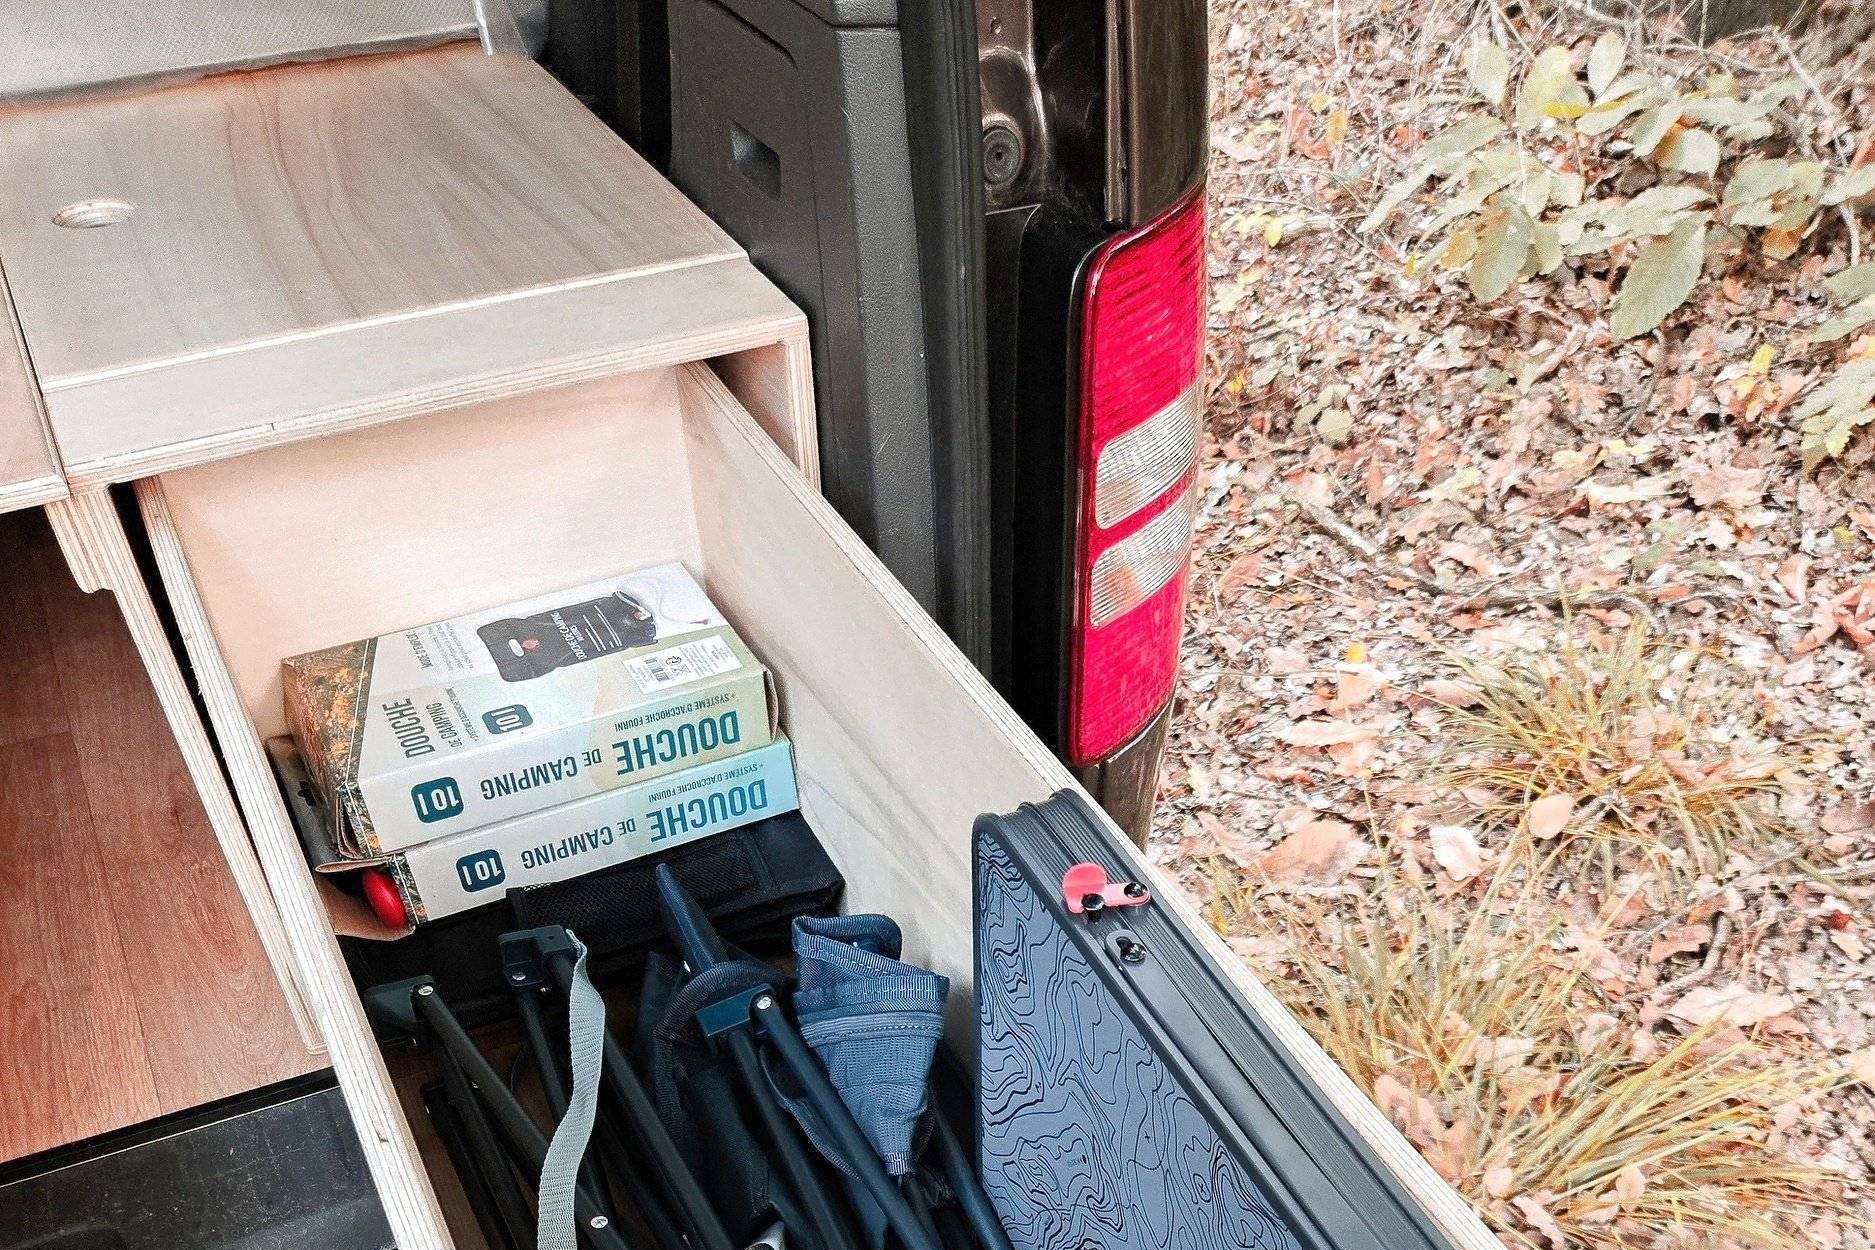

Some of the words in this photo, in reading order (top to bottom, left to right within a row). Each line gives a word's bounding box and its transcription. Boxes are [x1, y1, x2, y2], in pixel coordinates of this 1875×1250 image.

[426, 702, 458, 739] CAMPING
[495, 714, 523, 731] 10
[615, 718, 644, 732] FOURNI
[645, 702, 694, 725] D'ACCROCHE
[382, 698, 435, 758] DOUCHE
[448, 737, 463, 748] DE
[612, 710, 741, 775] DOUCHE
[582, 749, 602, 767] DE
[479, 756, 578, 801] CAMPING
[677, 774, 724, 795] D'ACCROCHE
[432, 786, 460, 811] 10
[648, 789, 677, 803] FOURNI
[646, 778, 769, 843] DOUCHE
[617, 817, 637, 836] DE
[521, 826, 614, 869] CAMPING
[475, 857, 502, 882] 10
